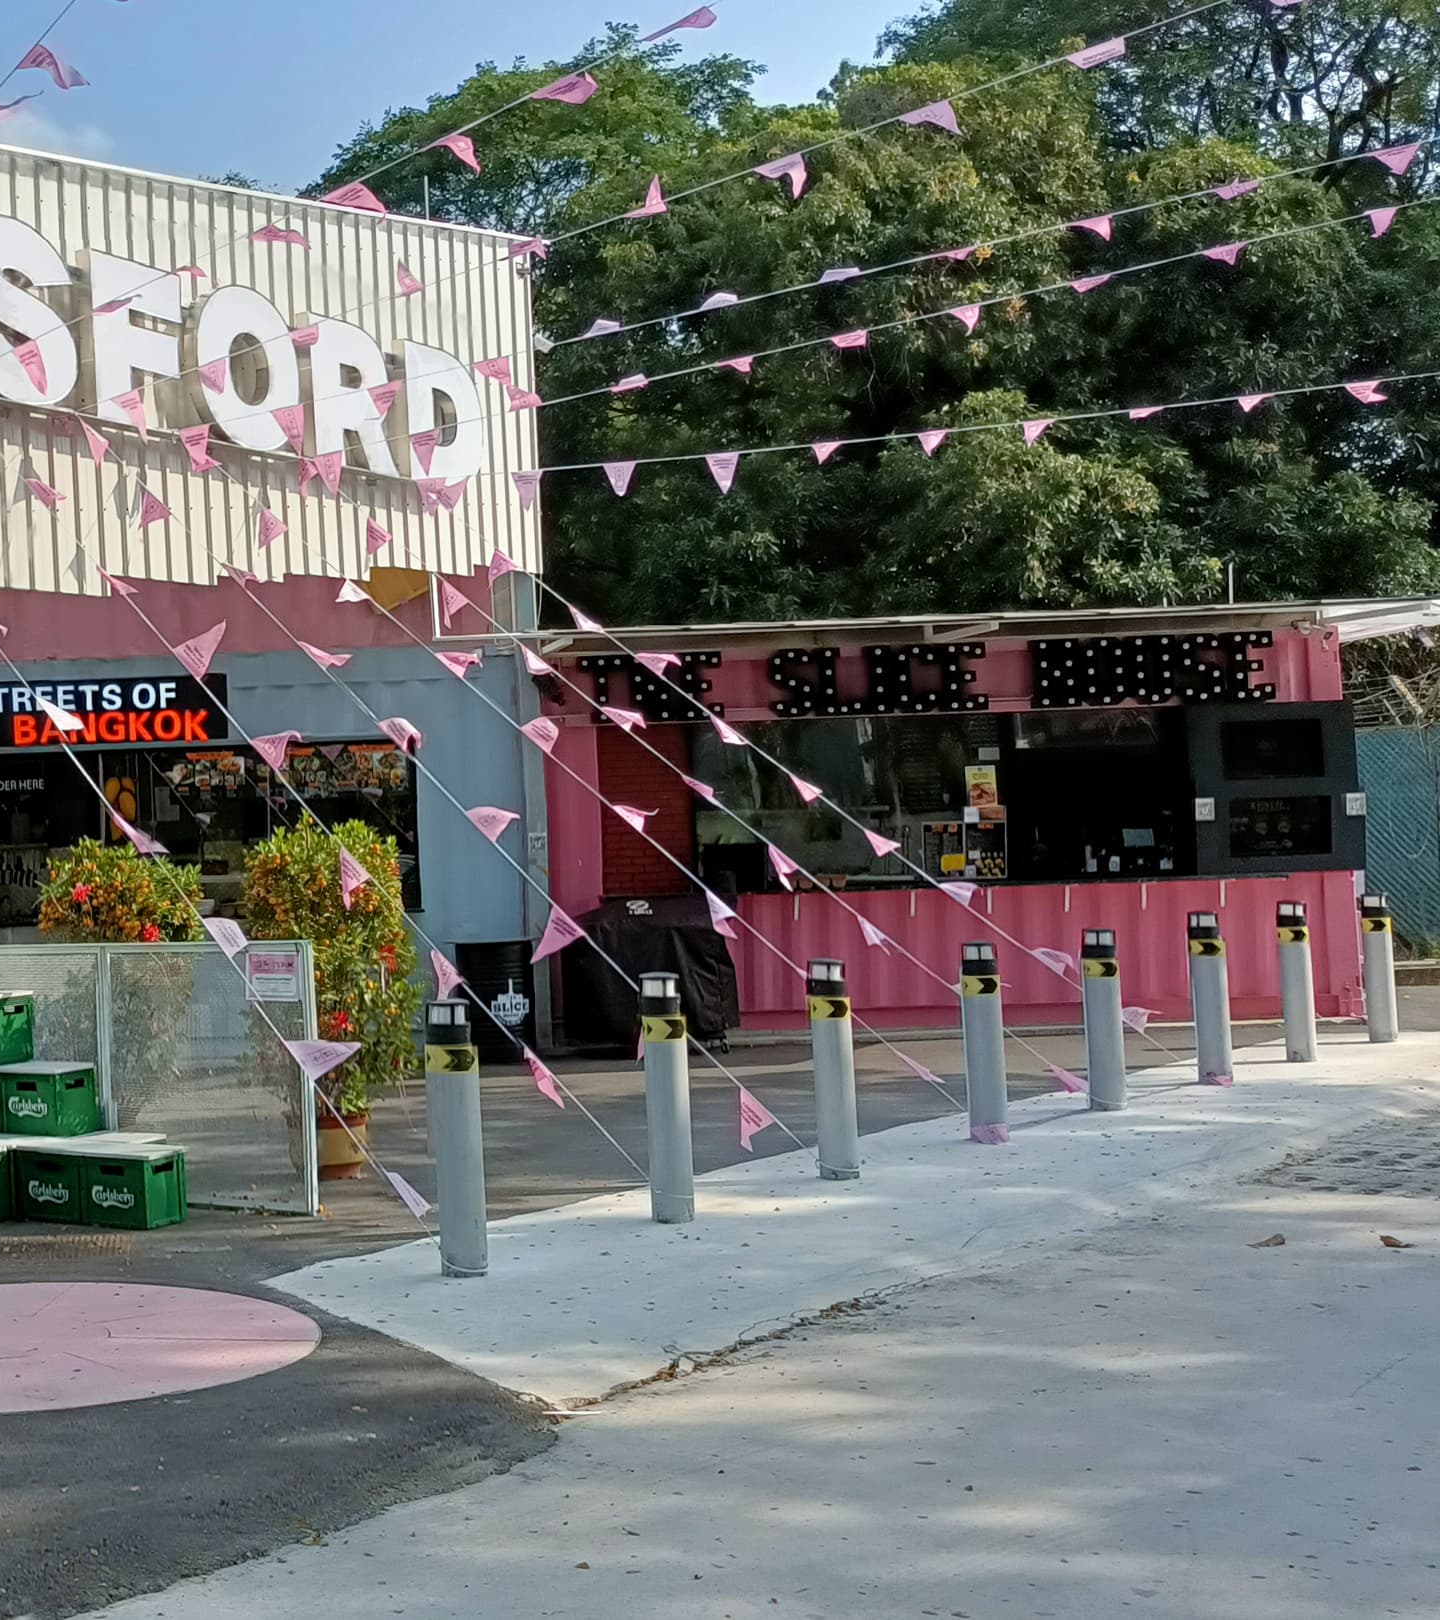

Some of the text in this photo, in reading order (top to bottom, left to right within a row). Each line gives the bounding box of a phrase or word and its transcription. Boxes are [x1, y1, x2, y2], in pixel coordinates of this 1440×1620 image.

[770, 641, 990, 718] SLICE
[132, 682, 177, 710] OF
[13, 709, 209, 746] BANGKOK
[19, 778, 45, 791] HERE
[8, 1096, 48, 1119] Carlsberg
[28, 1180, 70, 1204] Carlsberg
[91, 1185, 135, 1209] Carlsberg
